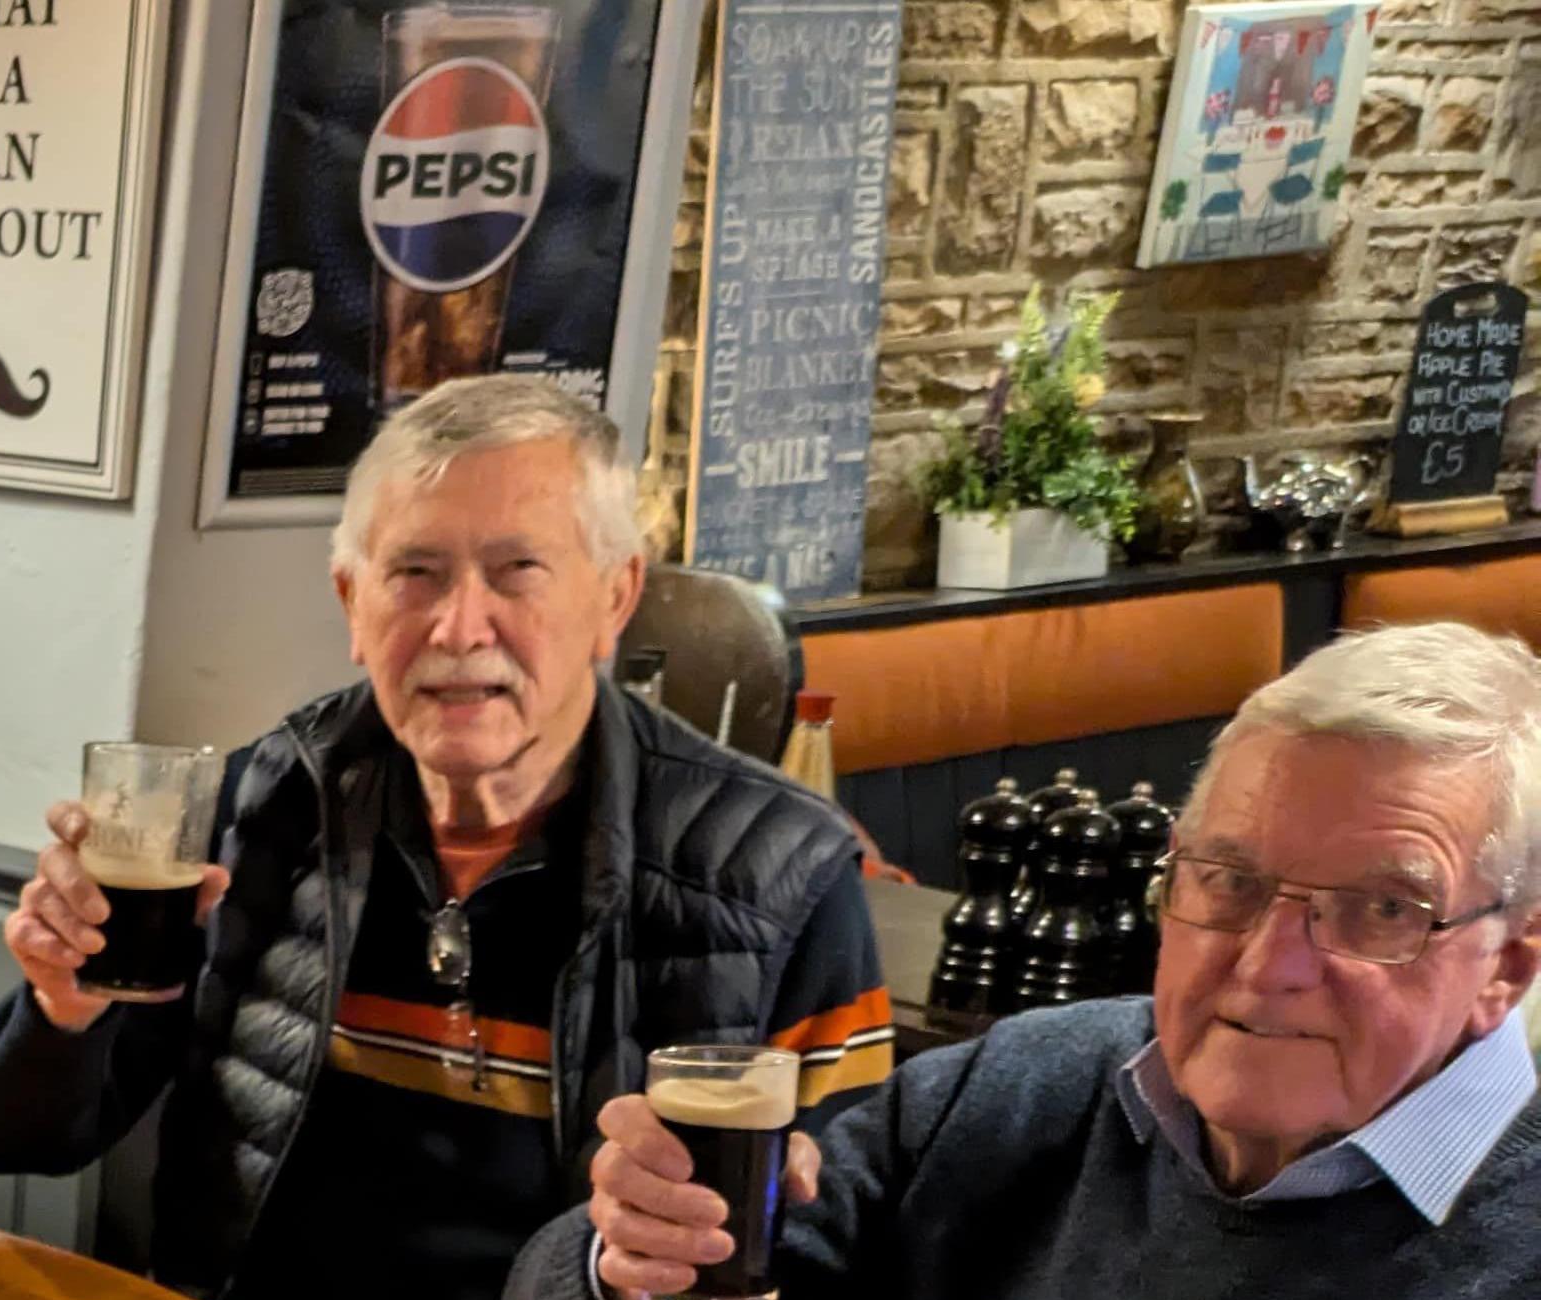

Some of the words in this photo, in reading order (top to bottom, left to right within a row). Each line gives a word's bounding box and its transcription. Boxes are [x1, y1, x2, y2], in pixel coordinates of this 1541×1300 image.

[373, 151, 537, 199] PEPSI
[849, 21, 895, 284] SANDCASTLES
[749, 301, 877, 346] PICNIC
[744, 350, 875, 393] BLANKET
[736, 435, 832, 490] SMILE
[1420, 441, 1464, 484] £5
